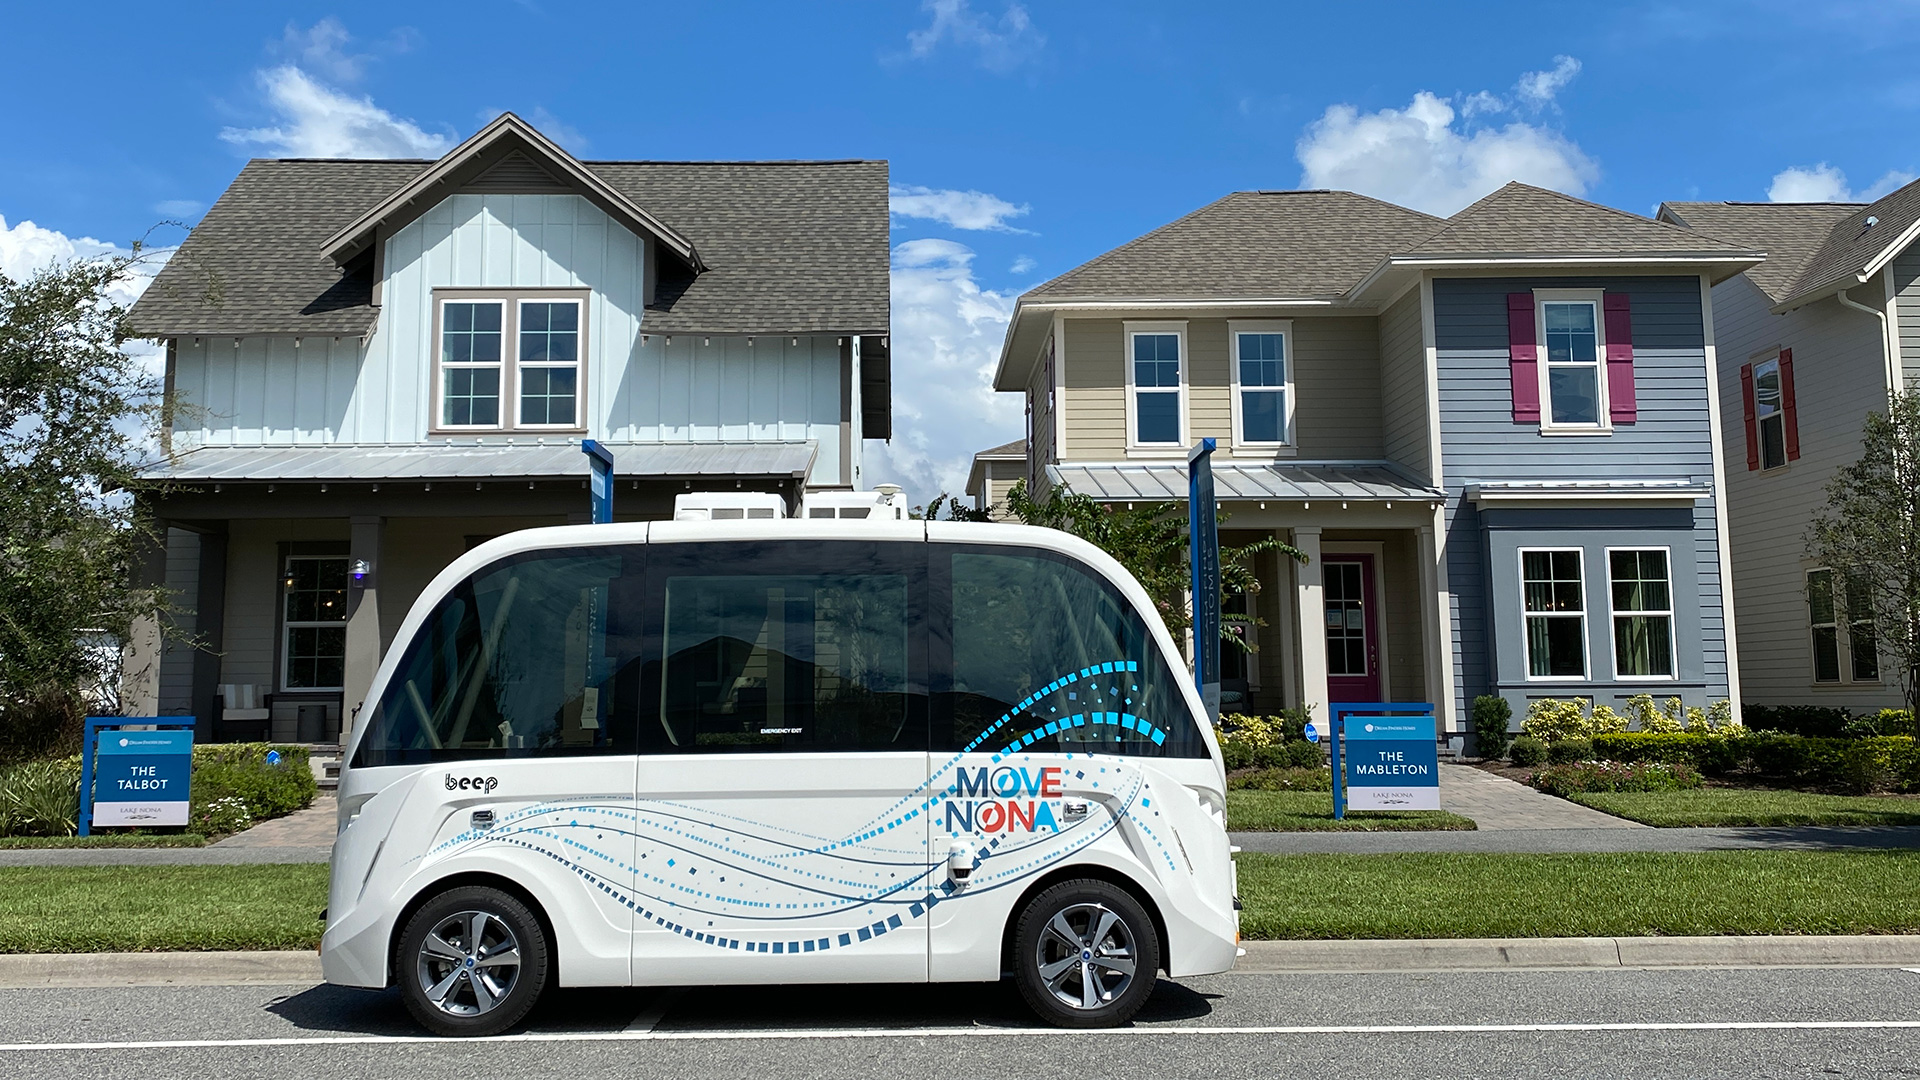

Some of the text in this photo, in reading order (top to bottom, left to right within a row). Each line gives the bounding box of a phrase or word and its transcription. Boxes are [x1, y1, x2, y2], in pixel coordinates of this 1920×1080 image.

[1379, 751, 1403, 761] THE
[131, 766, 155, 776] THE
[1356, 765, 1428, 775] MABLETON
[117, 779, 168, 790] TALBOT
[445, 773, 498, 794] beep
[957, 766, 1062, 798] MOVE
[946, 800, 1058, 833] NONA
